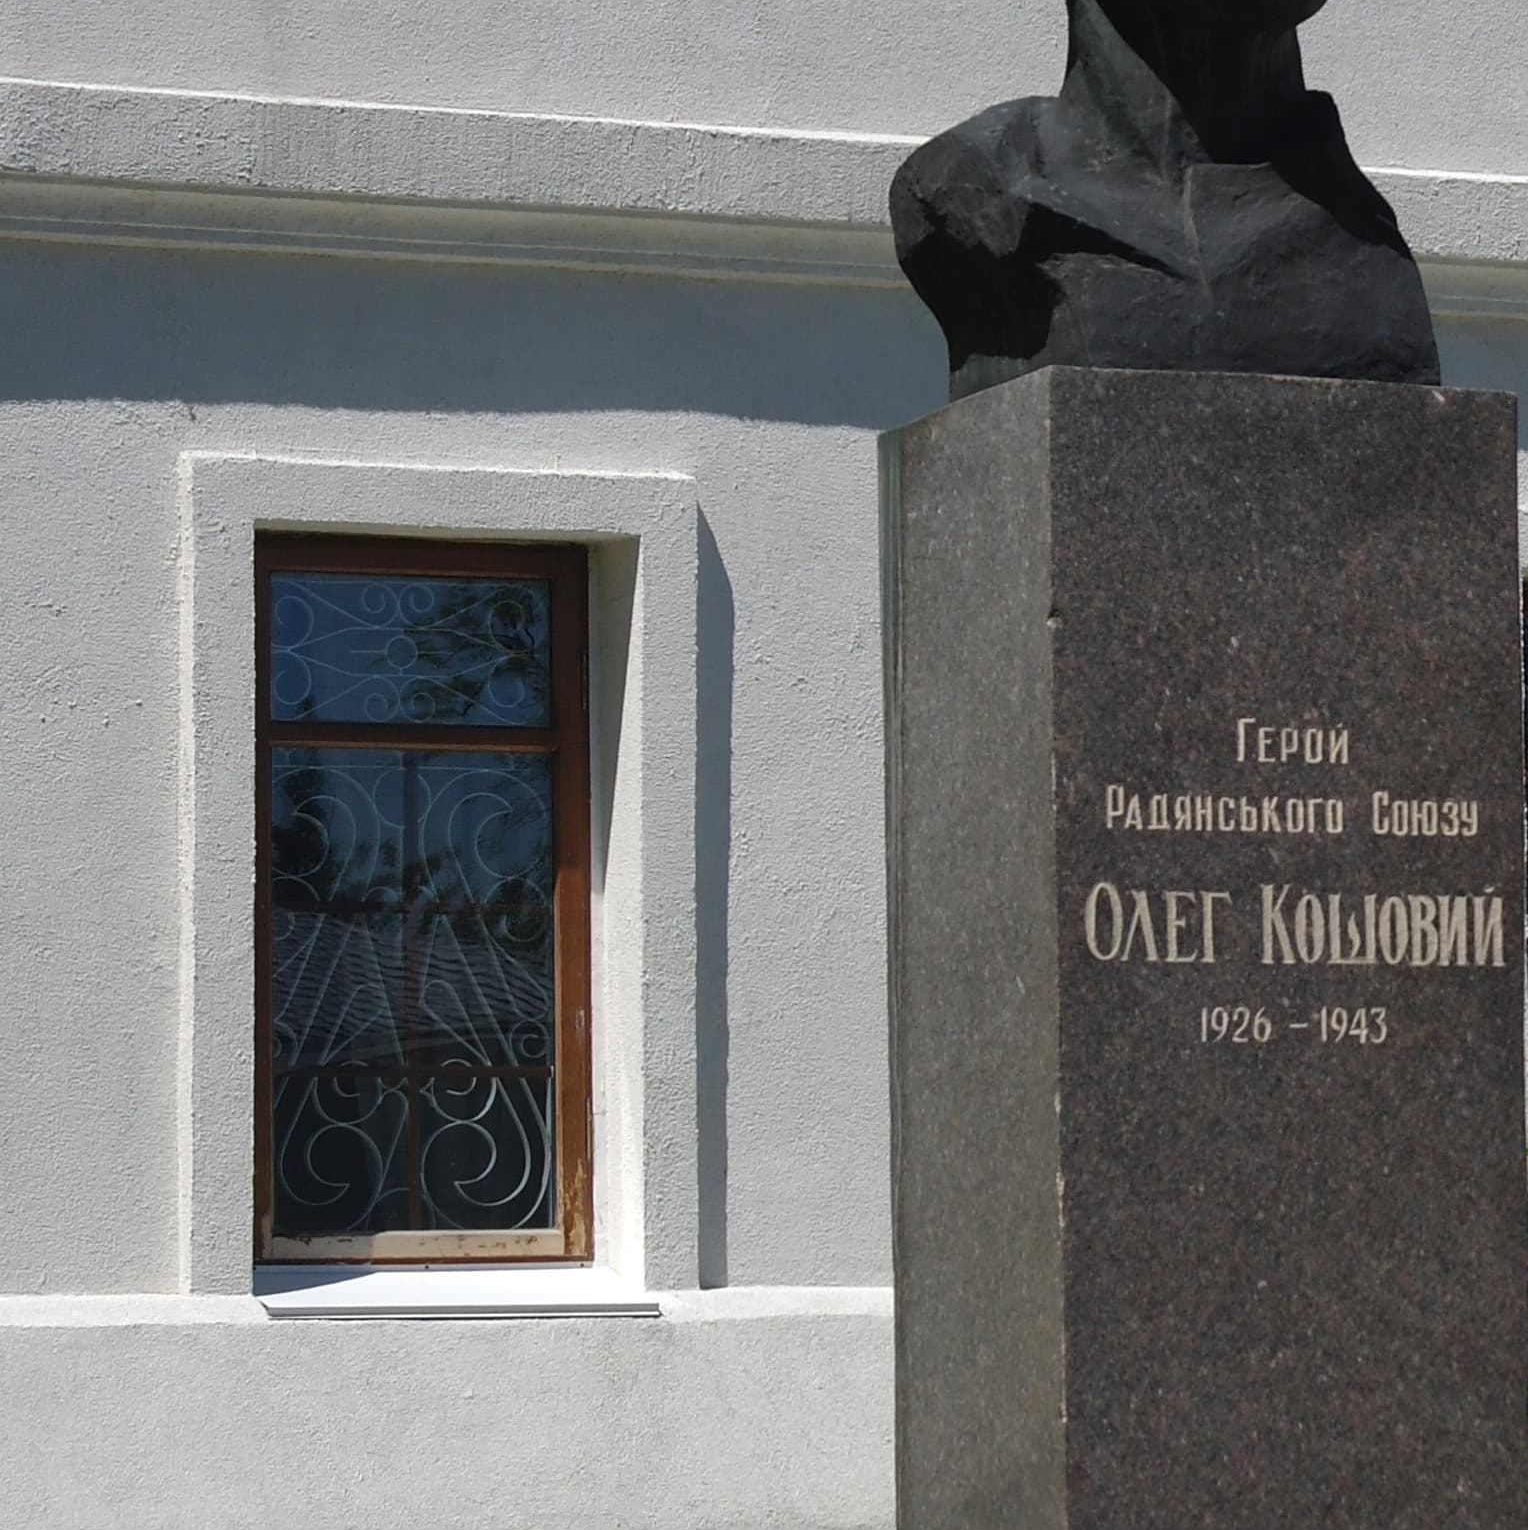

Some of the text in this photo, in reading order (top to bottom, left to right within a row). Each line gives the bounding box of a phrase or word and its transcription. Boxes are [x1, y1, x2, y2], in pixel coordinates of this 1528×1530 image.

[1236, 717, 1349, 764] ГЕРОЙ
[1106, 785, 1478, 836] РАДЯНСЬКОГО СОЮЗУ
[1084, 881, 1505, 967] ОЛЕГ КОШОВИЙ
